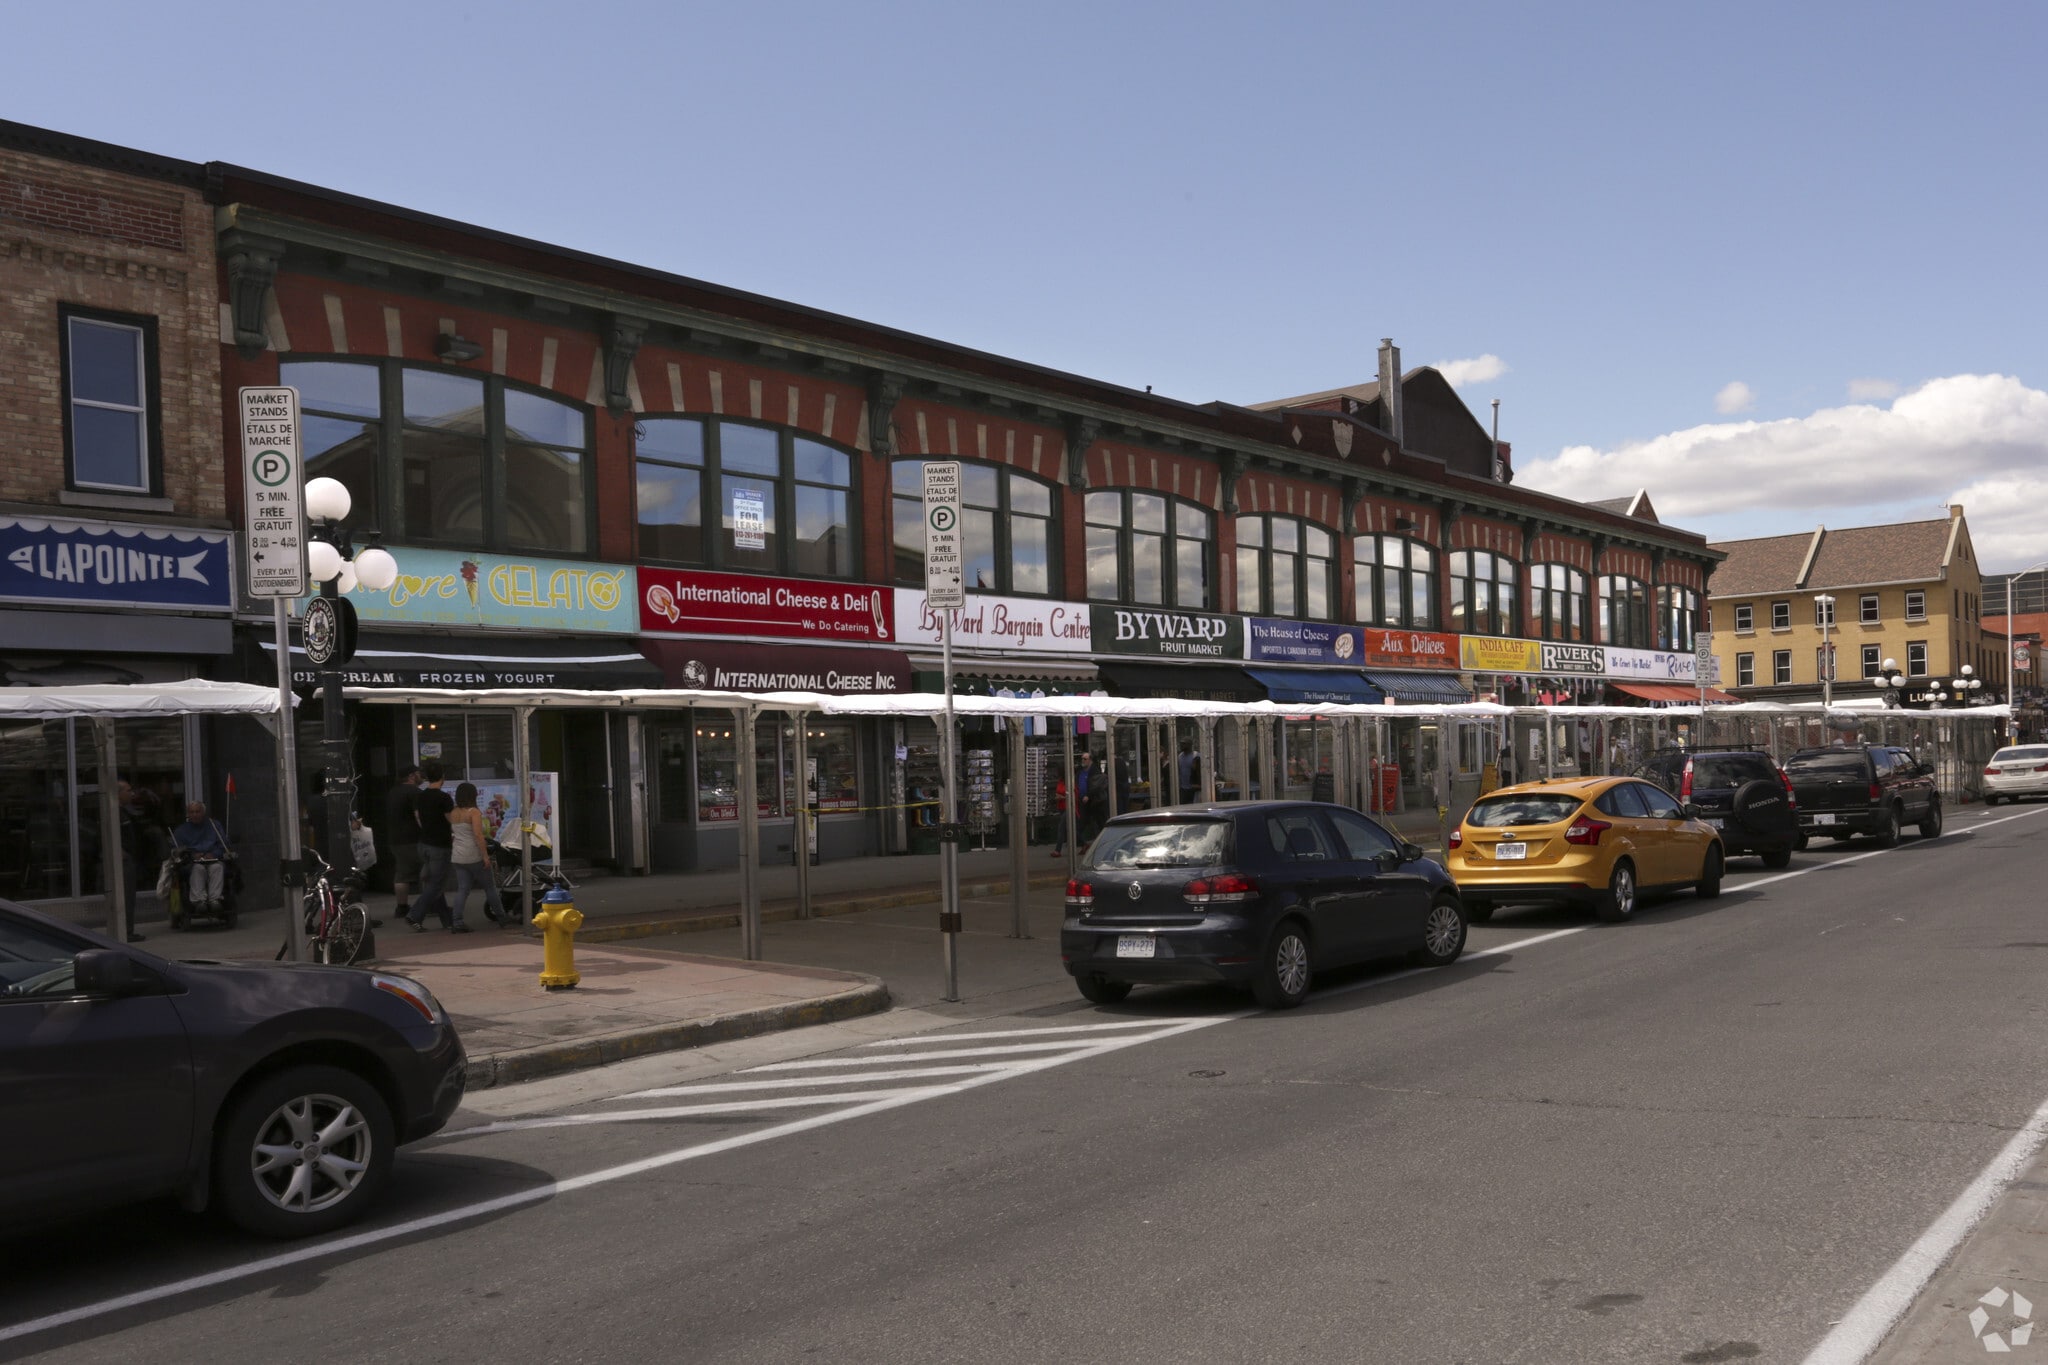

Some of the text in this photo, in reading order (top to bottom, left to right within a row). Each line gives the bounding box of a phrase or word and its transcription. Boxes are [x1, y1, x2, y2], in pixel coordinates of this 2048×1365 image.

[246, 394, 288, 405] MARKET
[249, 407, 288, 417] STANDS
[280, 424, 292, 434] DE
[263, 459, 279, 479] P
[926, 467, 955, 475] MARKET
[928, 475, 955, 483] STANDS
[256, 492, 290, 502] 15 MIN.
[259, 507, 285, 517] FREE
[740, 511, 759, 521] FOR
[937, 512, 948, 526] P
[253, 521, 293, 531] GRATUIT
[735, 521, 764, 531] LEASE
[38, 542, 174, 585] LAPOINTE
[257, 568, 277, 576] EVERY
[488, 564, 625, 611] GELATO
[676, 580, 869, 612] International Cheese & Deli
[802, 619, 870, 634] We Do Catering
[990, 603, 1044, 646] Bargain
[1050, 607, 1091, 640] Centre
[1252, 625, 1330, 641] The House of Cheese
[1160, 642, 1224, 656] FRUIT MARKET
[1381, 632, 1446, 655] Aux Délices
[1479, 640, 1504, 652] INDIA
[1542, 646, 1605, 672] RIVERS
[293, 671, 395, 683] CE REAM
[419, 673, 556, 684] FROZEN YOGURT
[713, 667, 897, 690] INTERNATIONAL CHEESE INC.
[1304, 692, 1312, 700] The
[1312, 692, 1326, 700] House
[1747, 796, 1781, 810] HONDA
